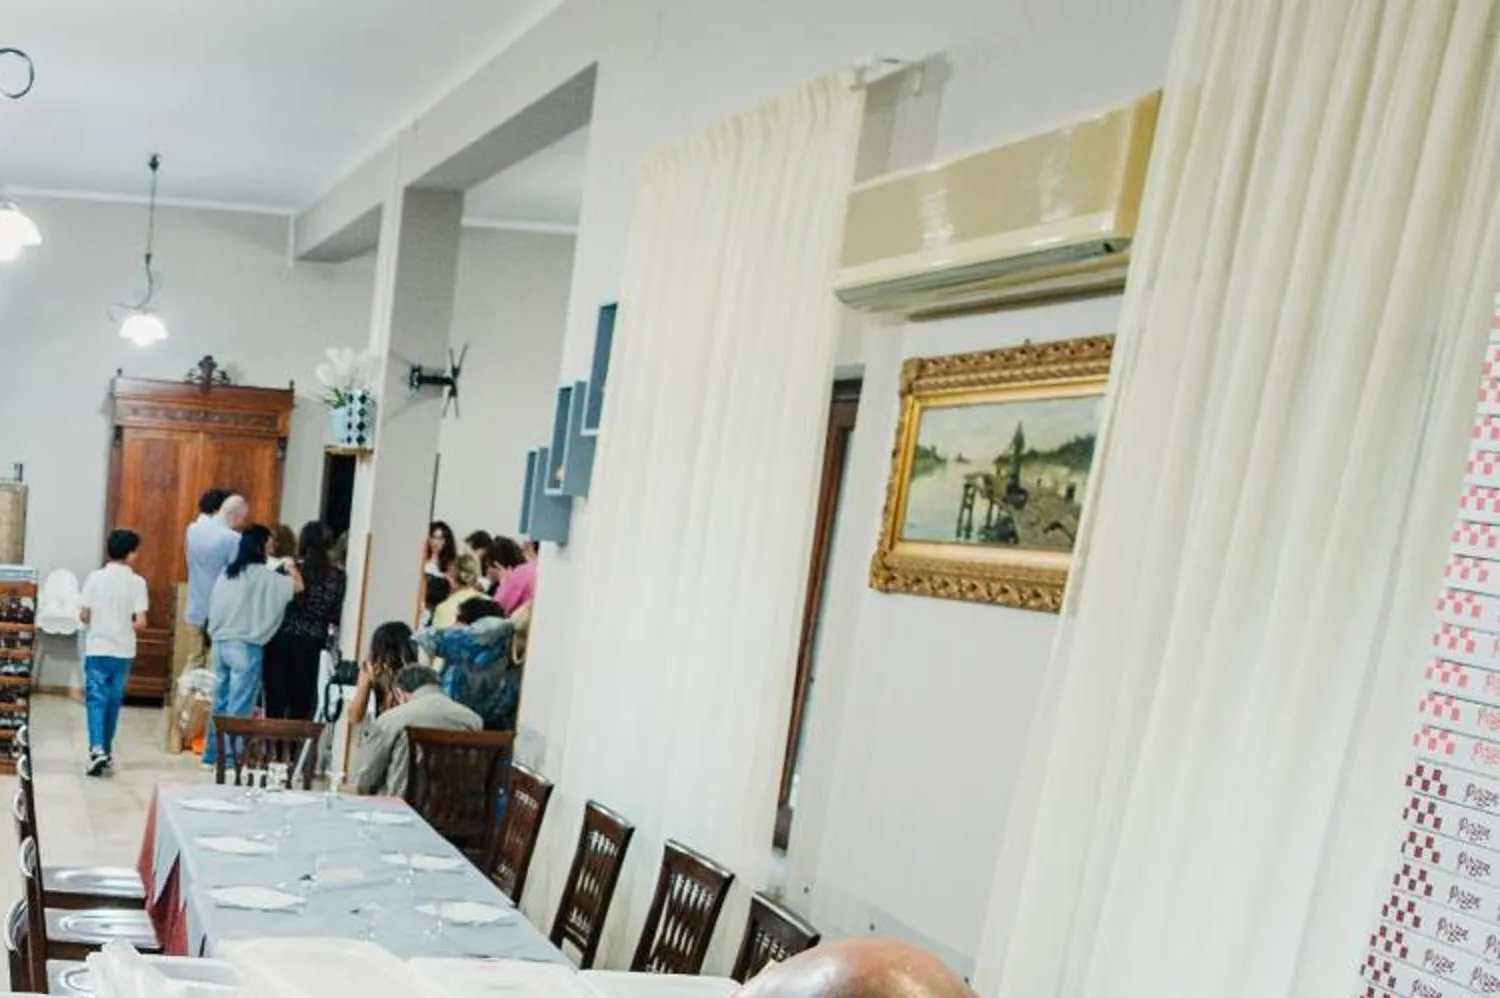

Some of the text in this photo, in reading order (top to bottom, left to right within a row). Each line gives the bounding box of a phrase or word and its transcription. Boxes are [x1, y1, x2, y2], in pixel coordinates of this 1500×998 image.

[1463, 784, 1499, 807] Pizza
[1457, 817, 1490, 841] Pizza
[1457, 852, 1491, 877] Pizza
[1447, 885, 1481, 910] Pizza
[1436, 917, 1469, 943] Pizza
[1423, 948, 1455, 974] Pizza
